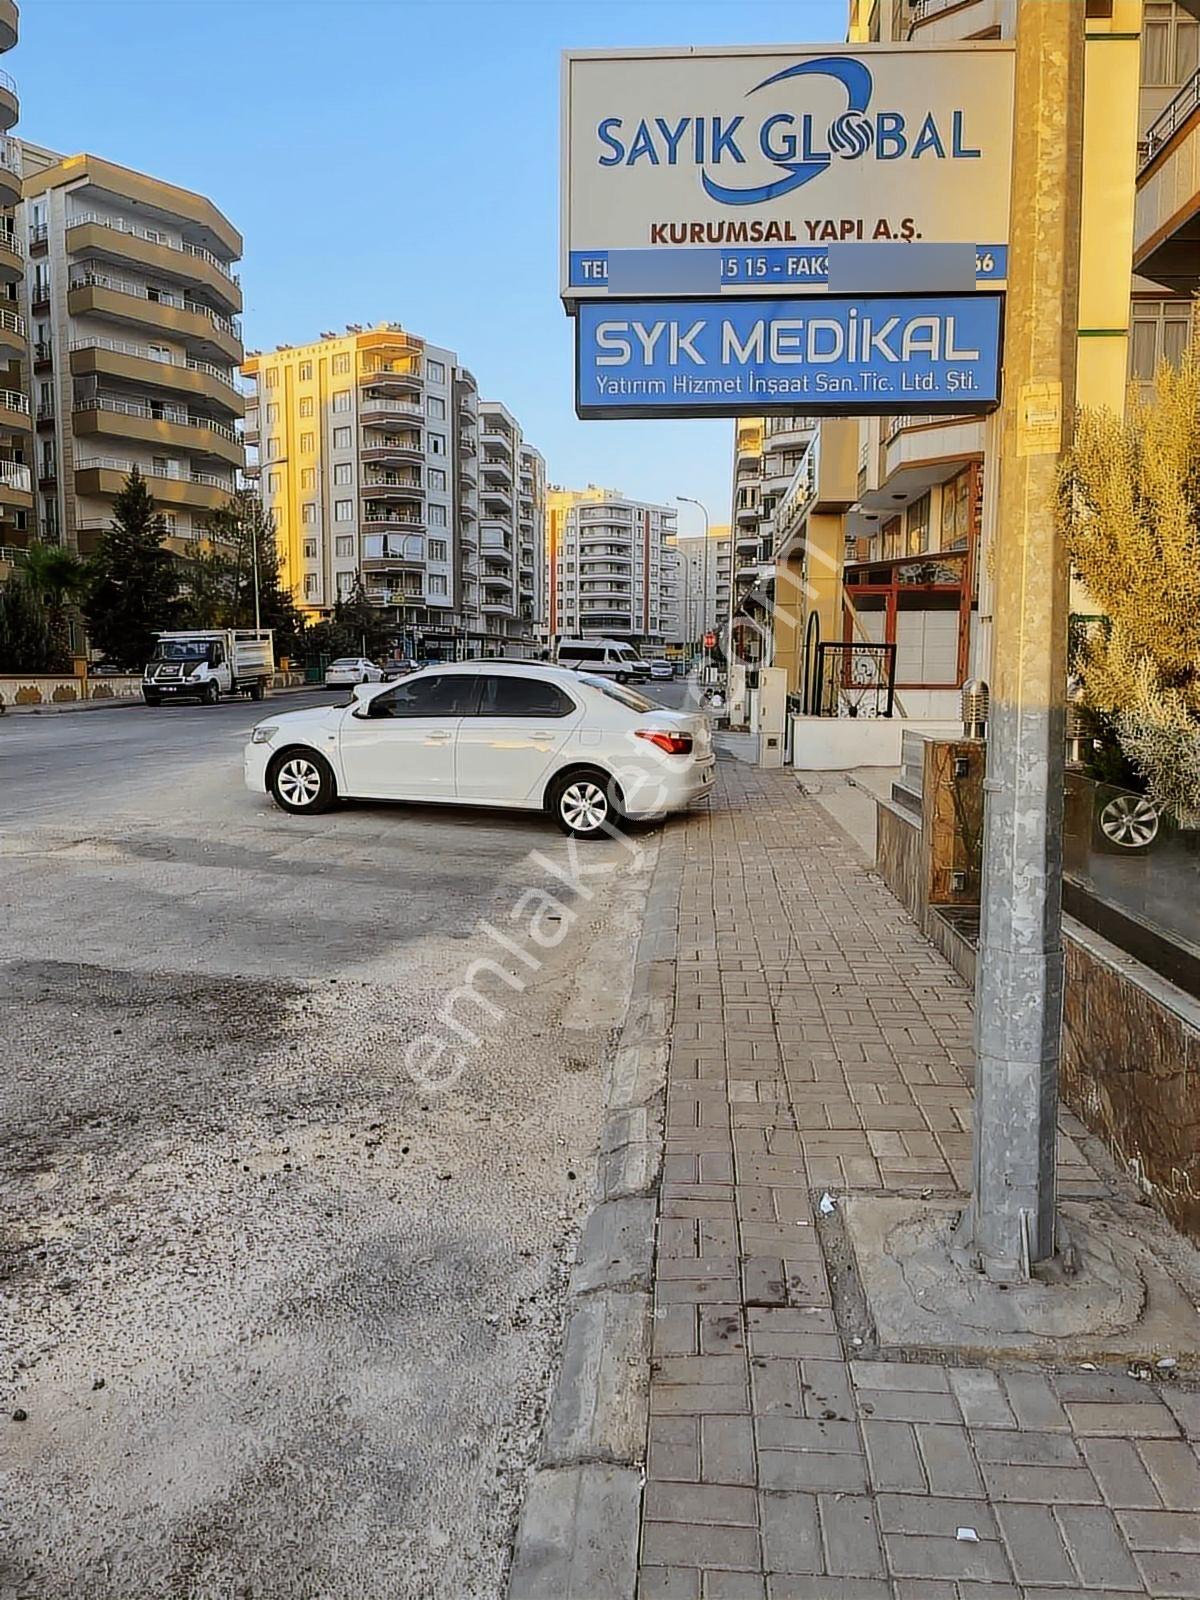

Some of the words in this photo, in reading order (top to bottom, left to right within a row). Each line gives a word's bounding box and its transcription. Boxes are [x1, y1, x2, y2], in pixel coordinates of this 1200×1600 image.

[598, 116, 746, 166] SAYIK
[760, 111, 981, 161] GLOBAL
[651, 220, 797, 244] KURUMSAL
[804, 219, 863, 241] YAPI
[872, 218, 922, 243] A.Ş.
[746, 258, 766, 276] 15
[596, 321, 707, 365] SYK
[722, 308, 979, 364] MEDİKAL
[596, 375, 665, 394] Yatırım
[673, 374, 742, 393] Hizmet
[749, 371, 808, 394] İnşaat
[902, 371, 939, 391] Ltd.
[947, 370, 979, 392] Şti.
